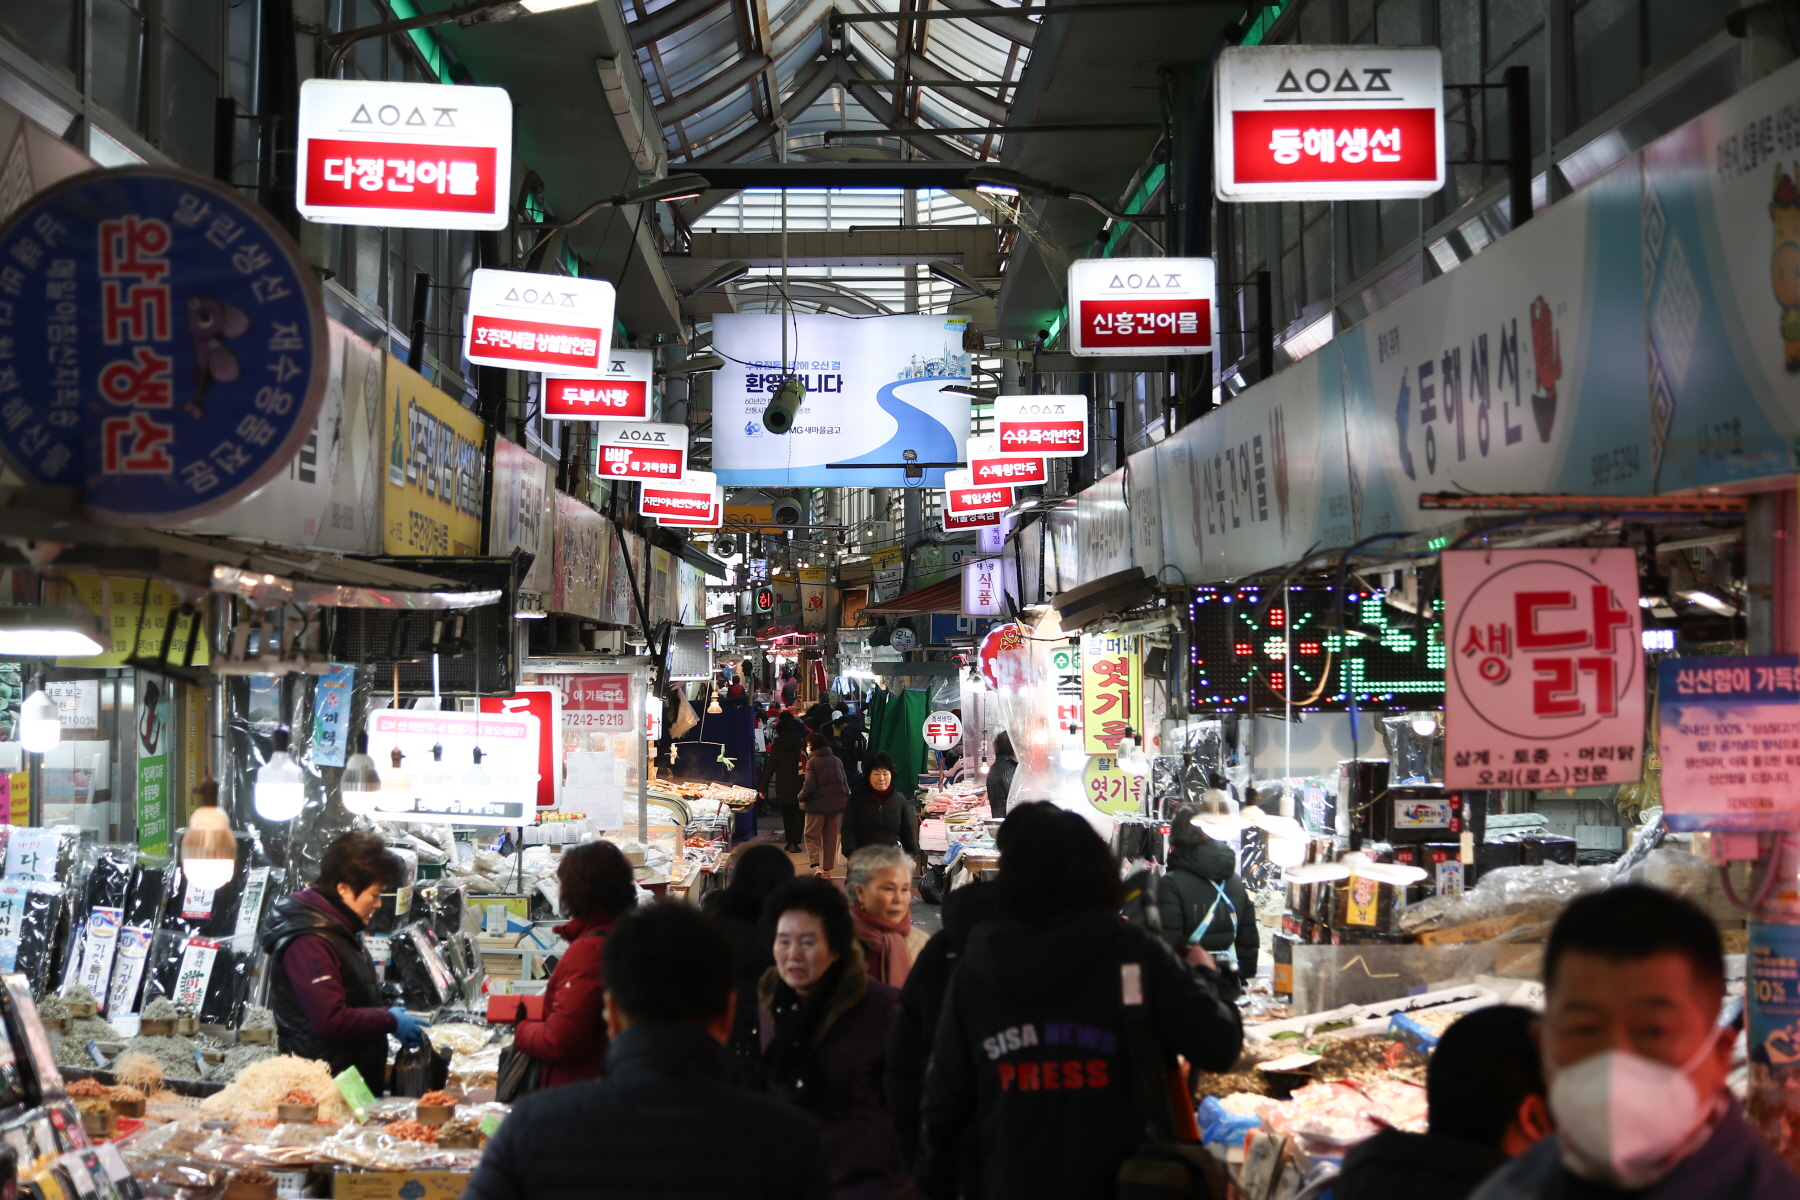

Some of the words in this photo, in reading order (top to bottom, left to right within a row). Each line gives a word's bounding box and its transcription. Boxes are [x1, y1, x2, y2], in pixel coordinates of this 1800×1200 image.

[1269, 127, 1401, 165] 동해생선
[323, 157, 480, 196] 다정건어물
[1092, 311, 1199, 335] 신흥건어물
[98, 214, 174, 476] 완도생선
[745, 360, 809, 371] 수유전통장에
[811, 360, 830, 370] 오신
[831, 361, 841, 370] 걸
[745, 373, 844, 394] 환영니다
[562, 387, 629, 407] 두부사랑
[1418, 317, 1523, 476] 동해생선
[805, 425, 841, 435] 새마을금고
[1002, 428, 1082, 445] 수유즉석반찬
[979, 461, 1038, 478] 수제왕만두
[1204, 434, 1269, 536] 신흥건어물
[759, 592, 771, 608] 회
[977, 573, 992, 606] 식품
[895, 629, 915, 644] 모닝
[1675, 668, 1751, 694] 신선함이
[926, 723, 959, 744] 두부
[1511, 748, 1550, 765] 토종
[1477, 766, 1609, 786] 오리(로스)전문
[982, 1022, 1039, 1060] SISA
[1044, 1021, 1118, 1055] NEWS
[997, 1058, 1110, 1091] PRESS
